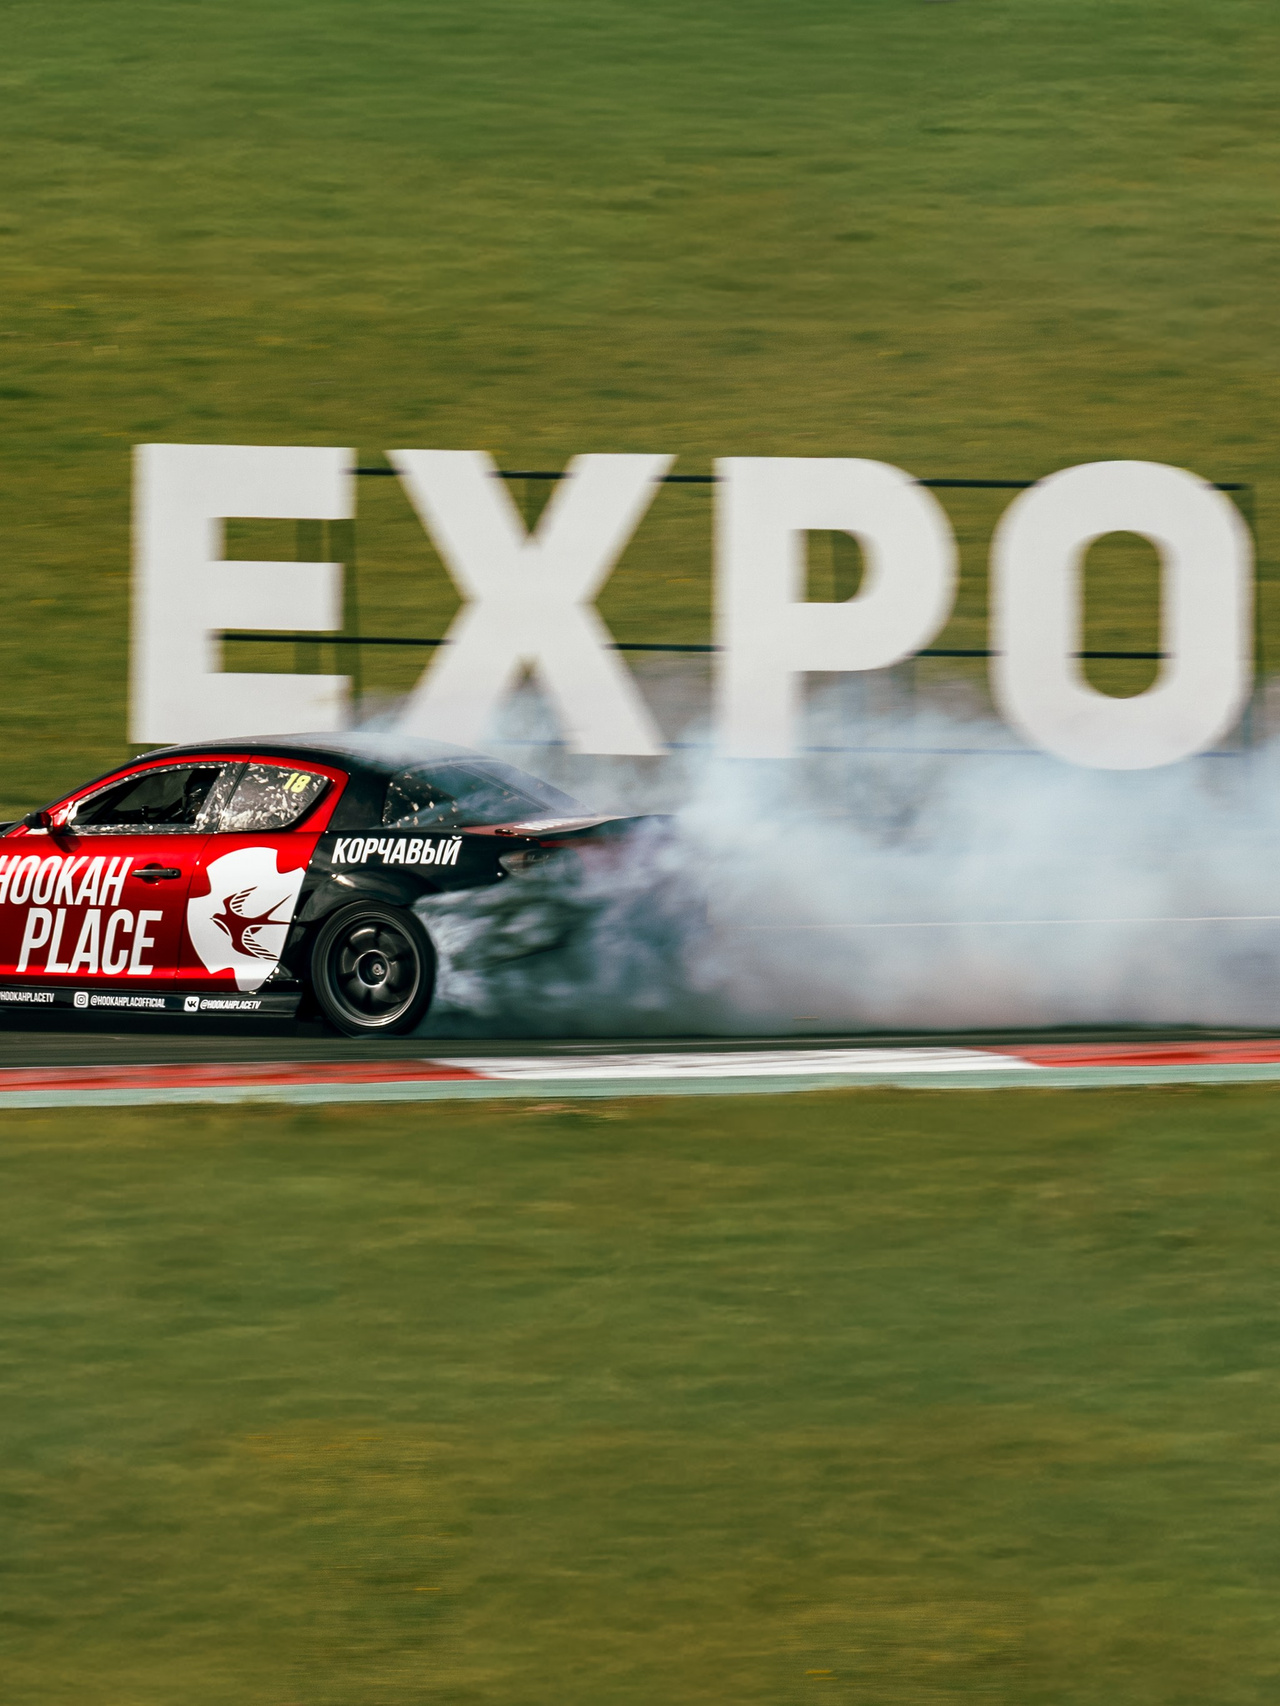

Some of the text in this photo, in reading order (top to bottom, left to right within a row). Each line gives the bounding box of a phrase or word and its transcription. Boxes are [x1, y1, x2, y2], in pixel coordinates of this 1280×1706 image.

[129, 443, 1256, 771] EXPO
[282, 772, 312, 793] 18
[331, 835, 463, 866] КОРЧАВЫЙ
[15, 907, 163, 975] PLACE
[200, 999, 262, 1010] @HOOKAHPLACETV
